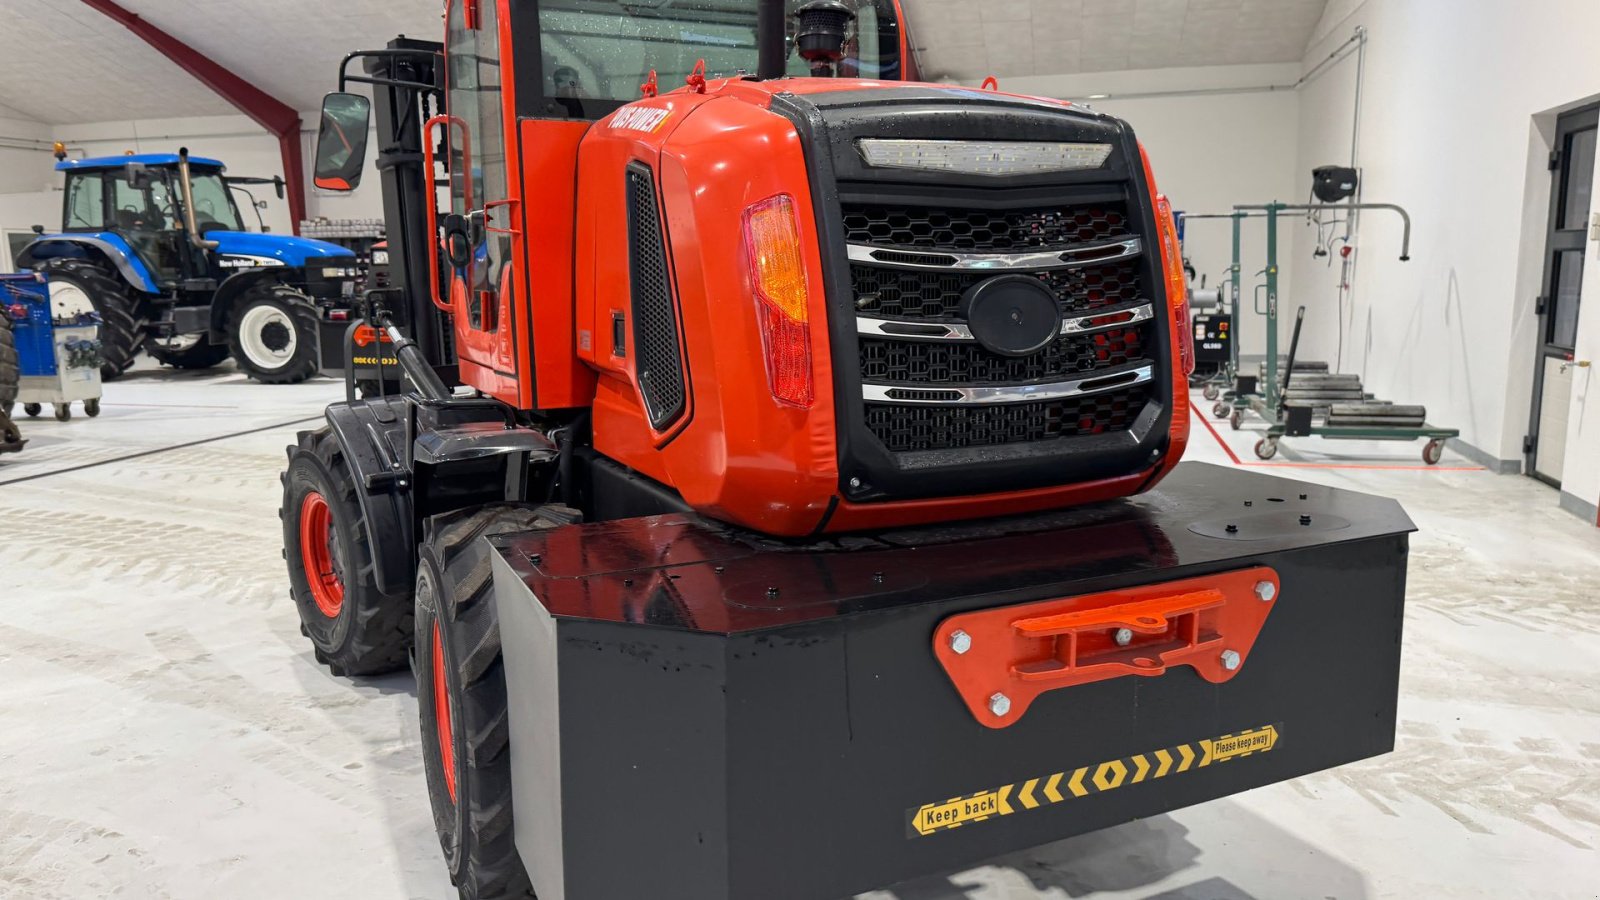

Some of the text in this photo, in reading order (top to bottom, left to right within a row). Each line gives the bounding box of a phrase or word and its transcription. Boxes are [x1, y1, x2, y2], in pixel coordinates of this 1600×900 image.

[219, 259, 233, 268] New
[233, 259, 255, 267] Holland
[1215, 734, 1269, 755] Please keep away
[926, 796, 995, 825] Keep back
